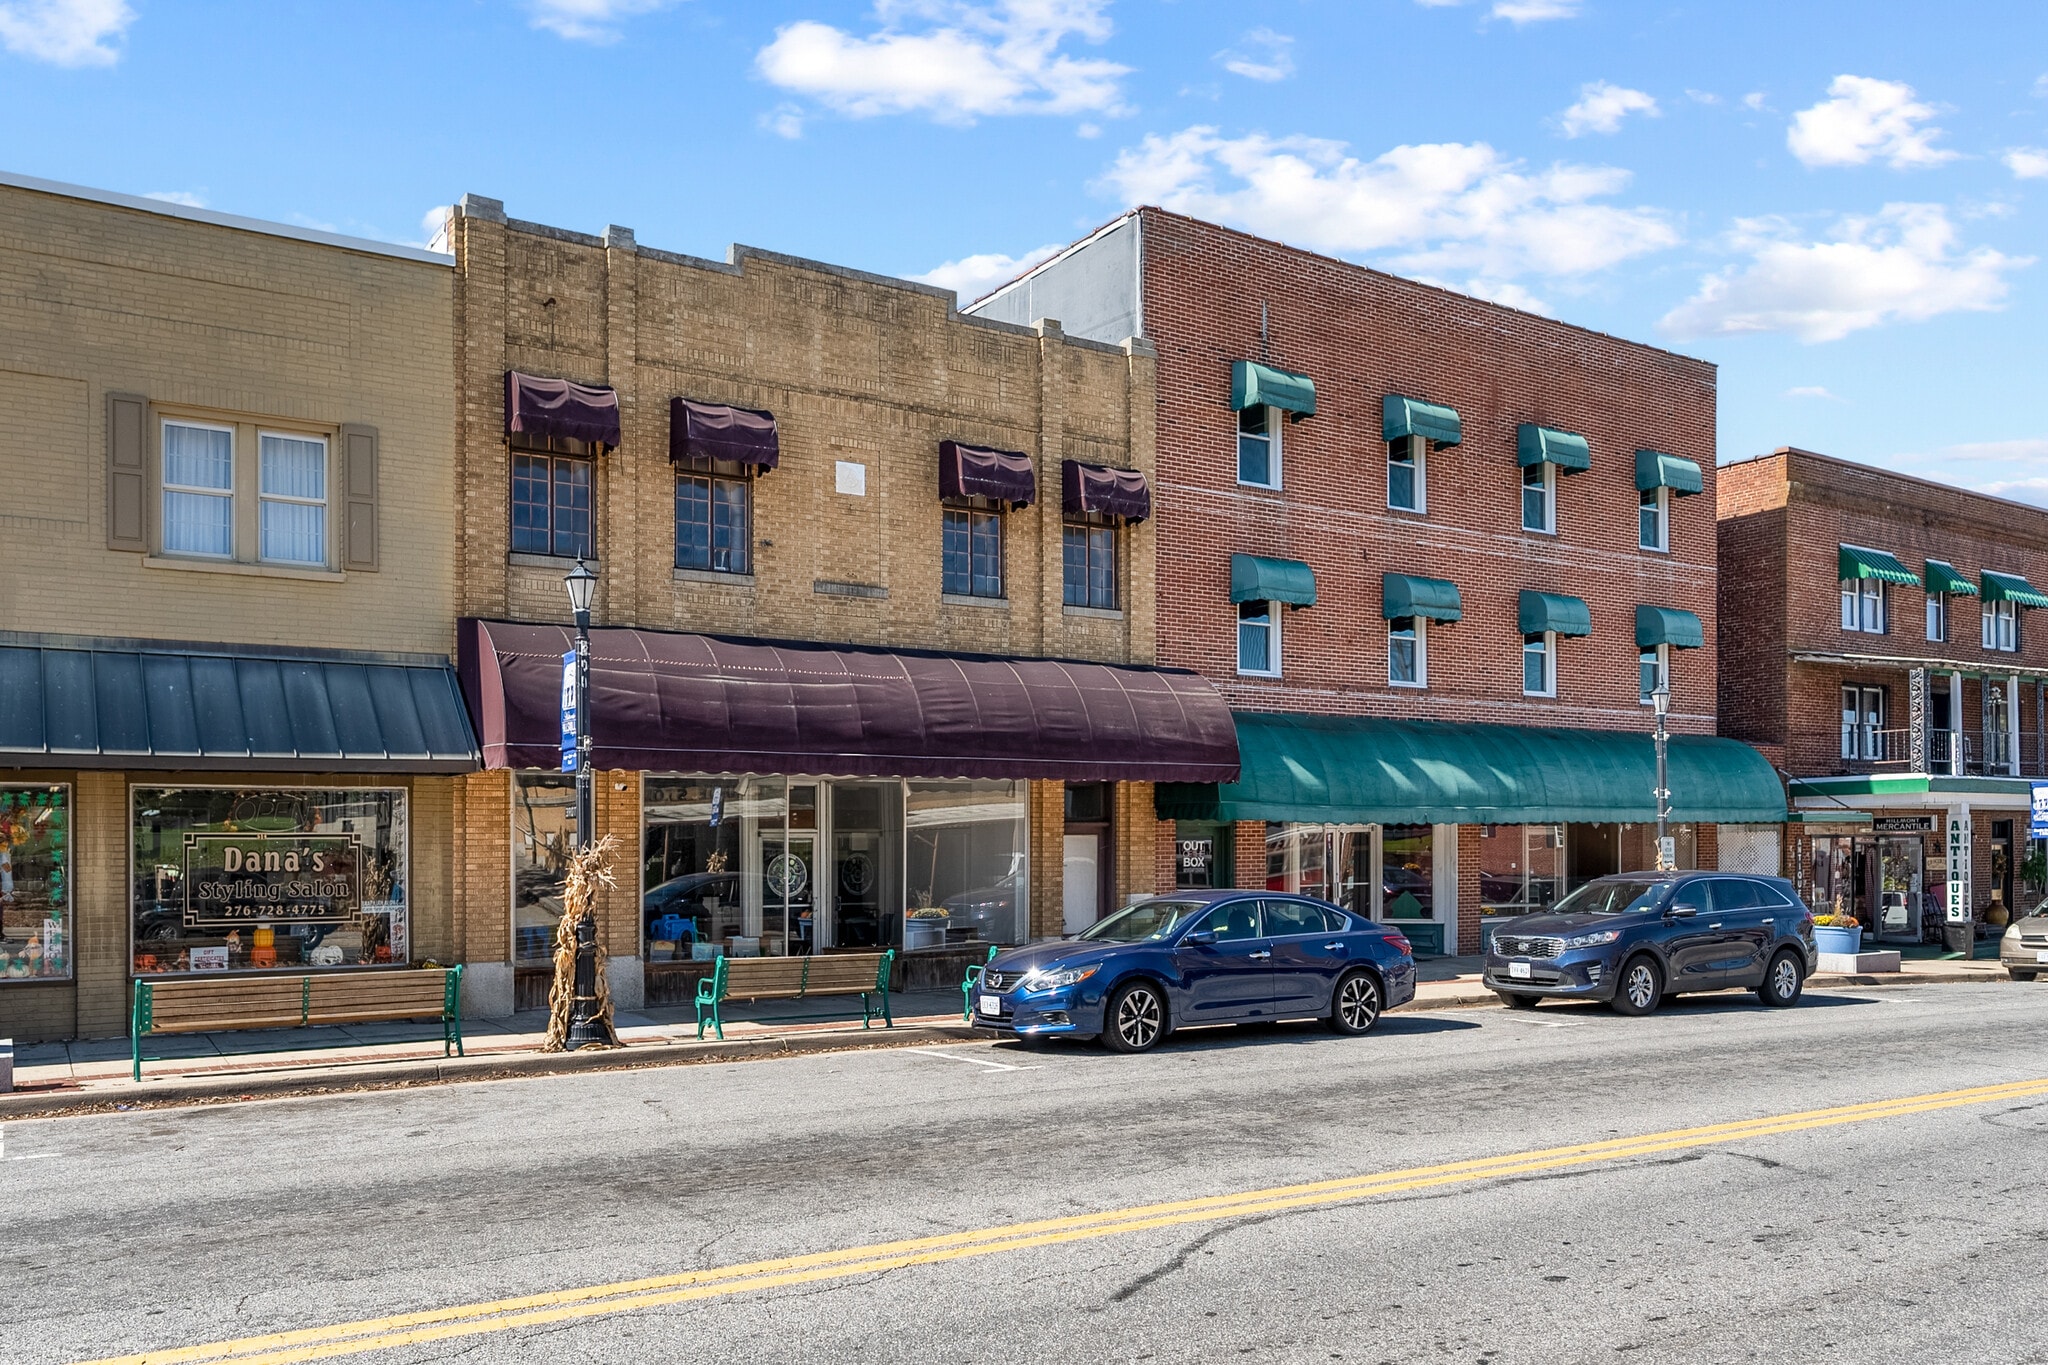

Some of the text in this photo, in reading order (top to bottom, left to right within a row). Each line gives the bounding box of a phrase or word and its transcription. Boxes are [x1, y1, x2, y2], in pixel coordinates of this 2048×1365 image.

[235, 801, 311, 824] OPEN
[1876, 822, 1930, 830] MERCANTILE
[1183, 840, 1205, 851] OUT
[223, 846, 325, 873] Dana's
[1183, 857, 1205, 867] BOX
[1950, 820, 1960, 917] ANTIQUES
[199, 878, 350, 902] Styling Salon
[224, 904, 325, 917] 276-728-4775
